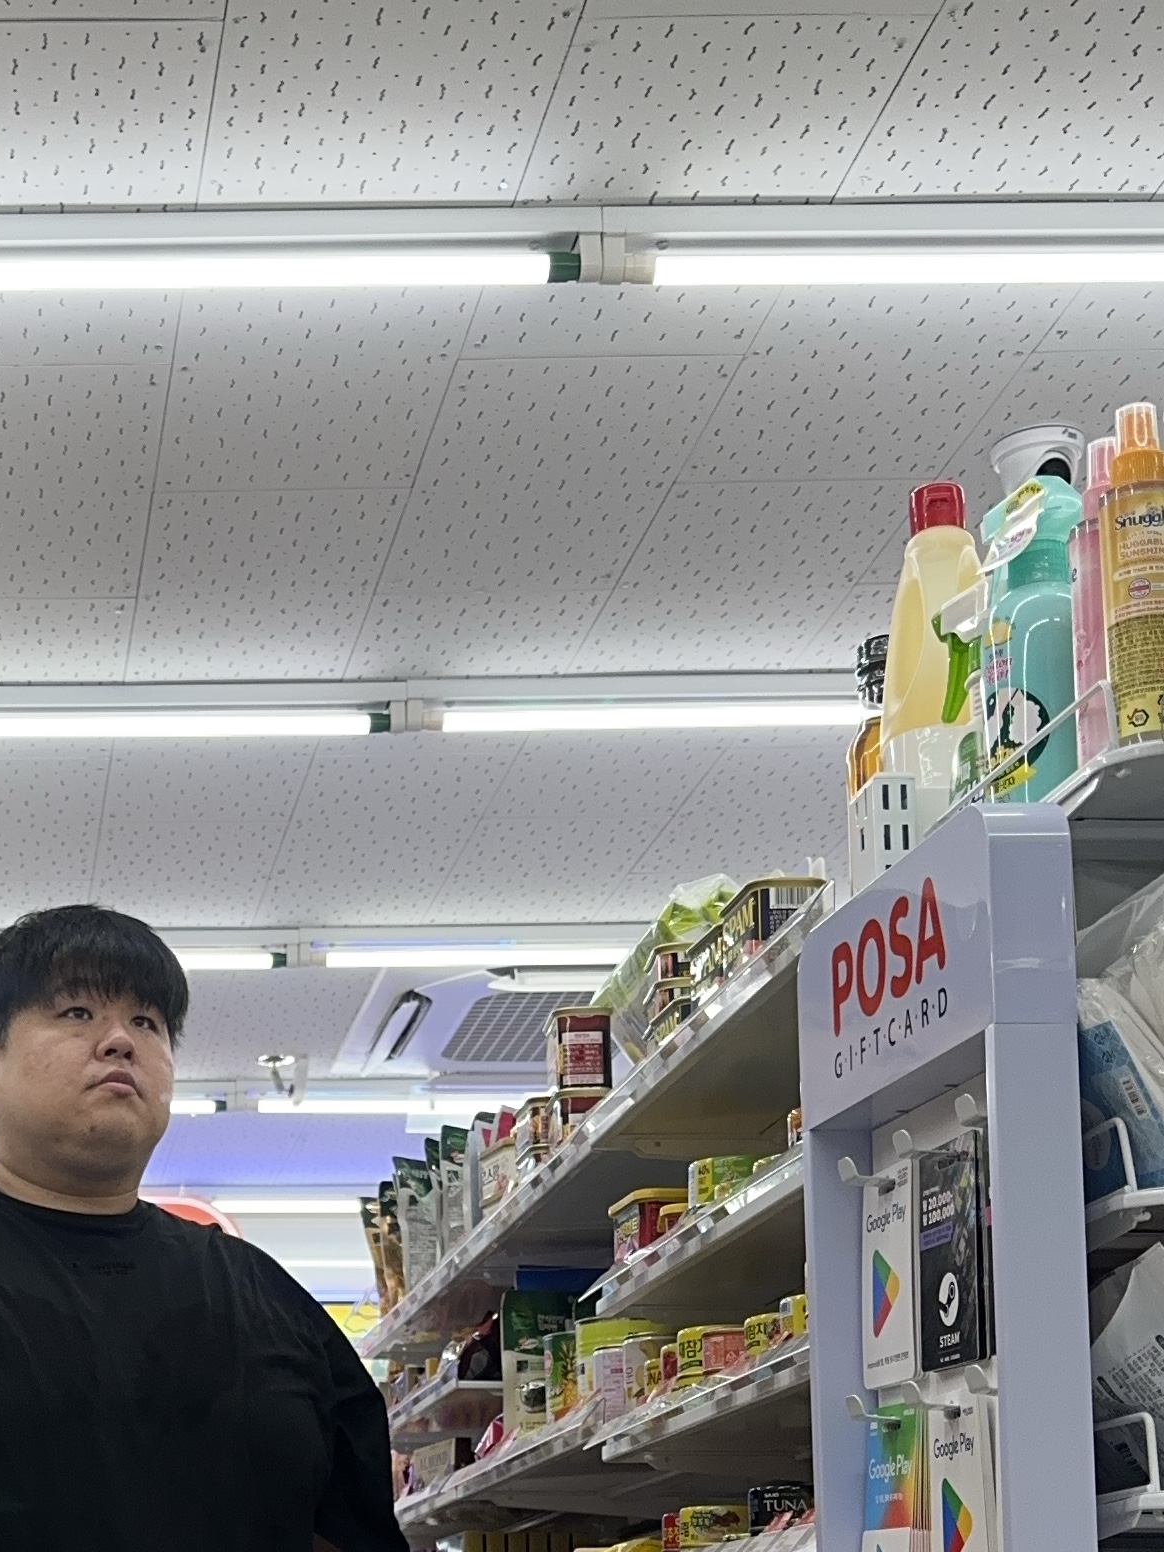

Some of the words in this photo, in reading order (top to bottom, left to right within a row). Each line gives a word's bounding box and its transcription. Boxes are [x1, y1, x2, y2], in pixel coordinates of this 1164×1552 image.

[830, 876, 948, 1037] POSA
[866, 1208, 892, 1235] Google
[892, 1200, 907, 1224] Play
[940, 1331, 961, 1349] STEAM
[934, 1435, 959, 1461] Google
[959, 1432, 975, 1456] Play
[868, 1456, 896, 1484] Google
[896, 1454, 911, 1479] Play
[763, 1499, 808, 1512] TUNA
